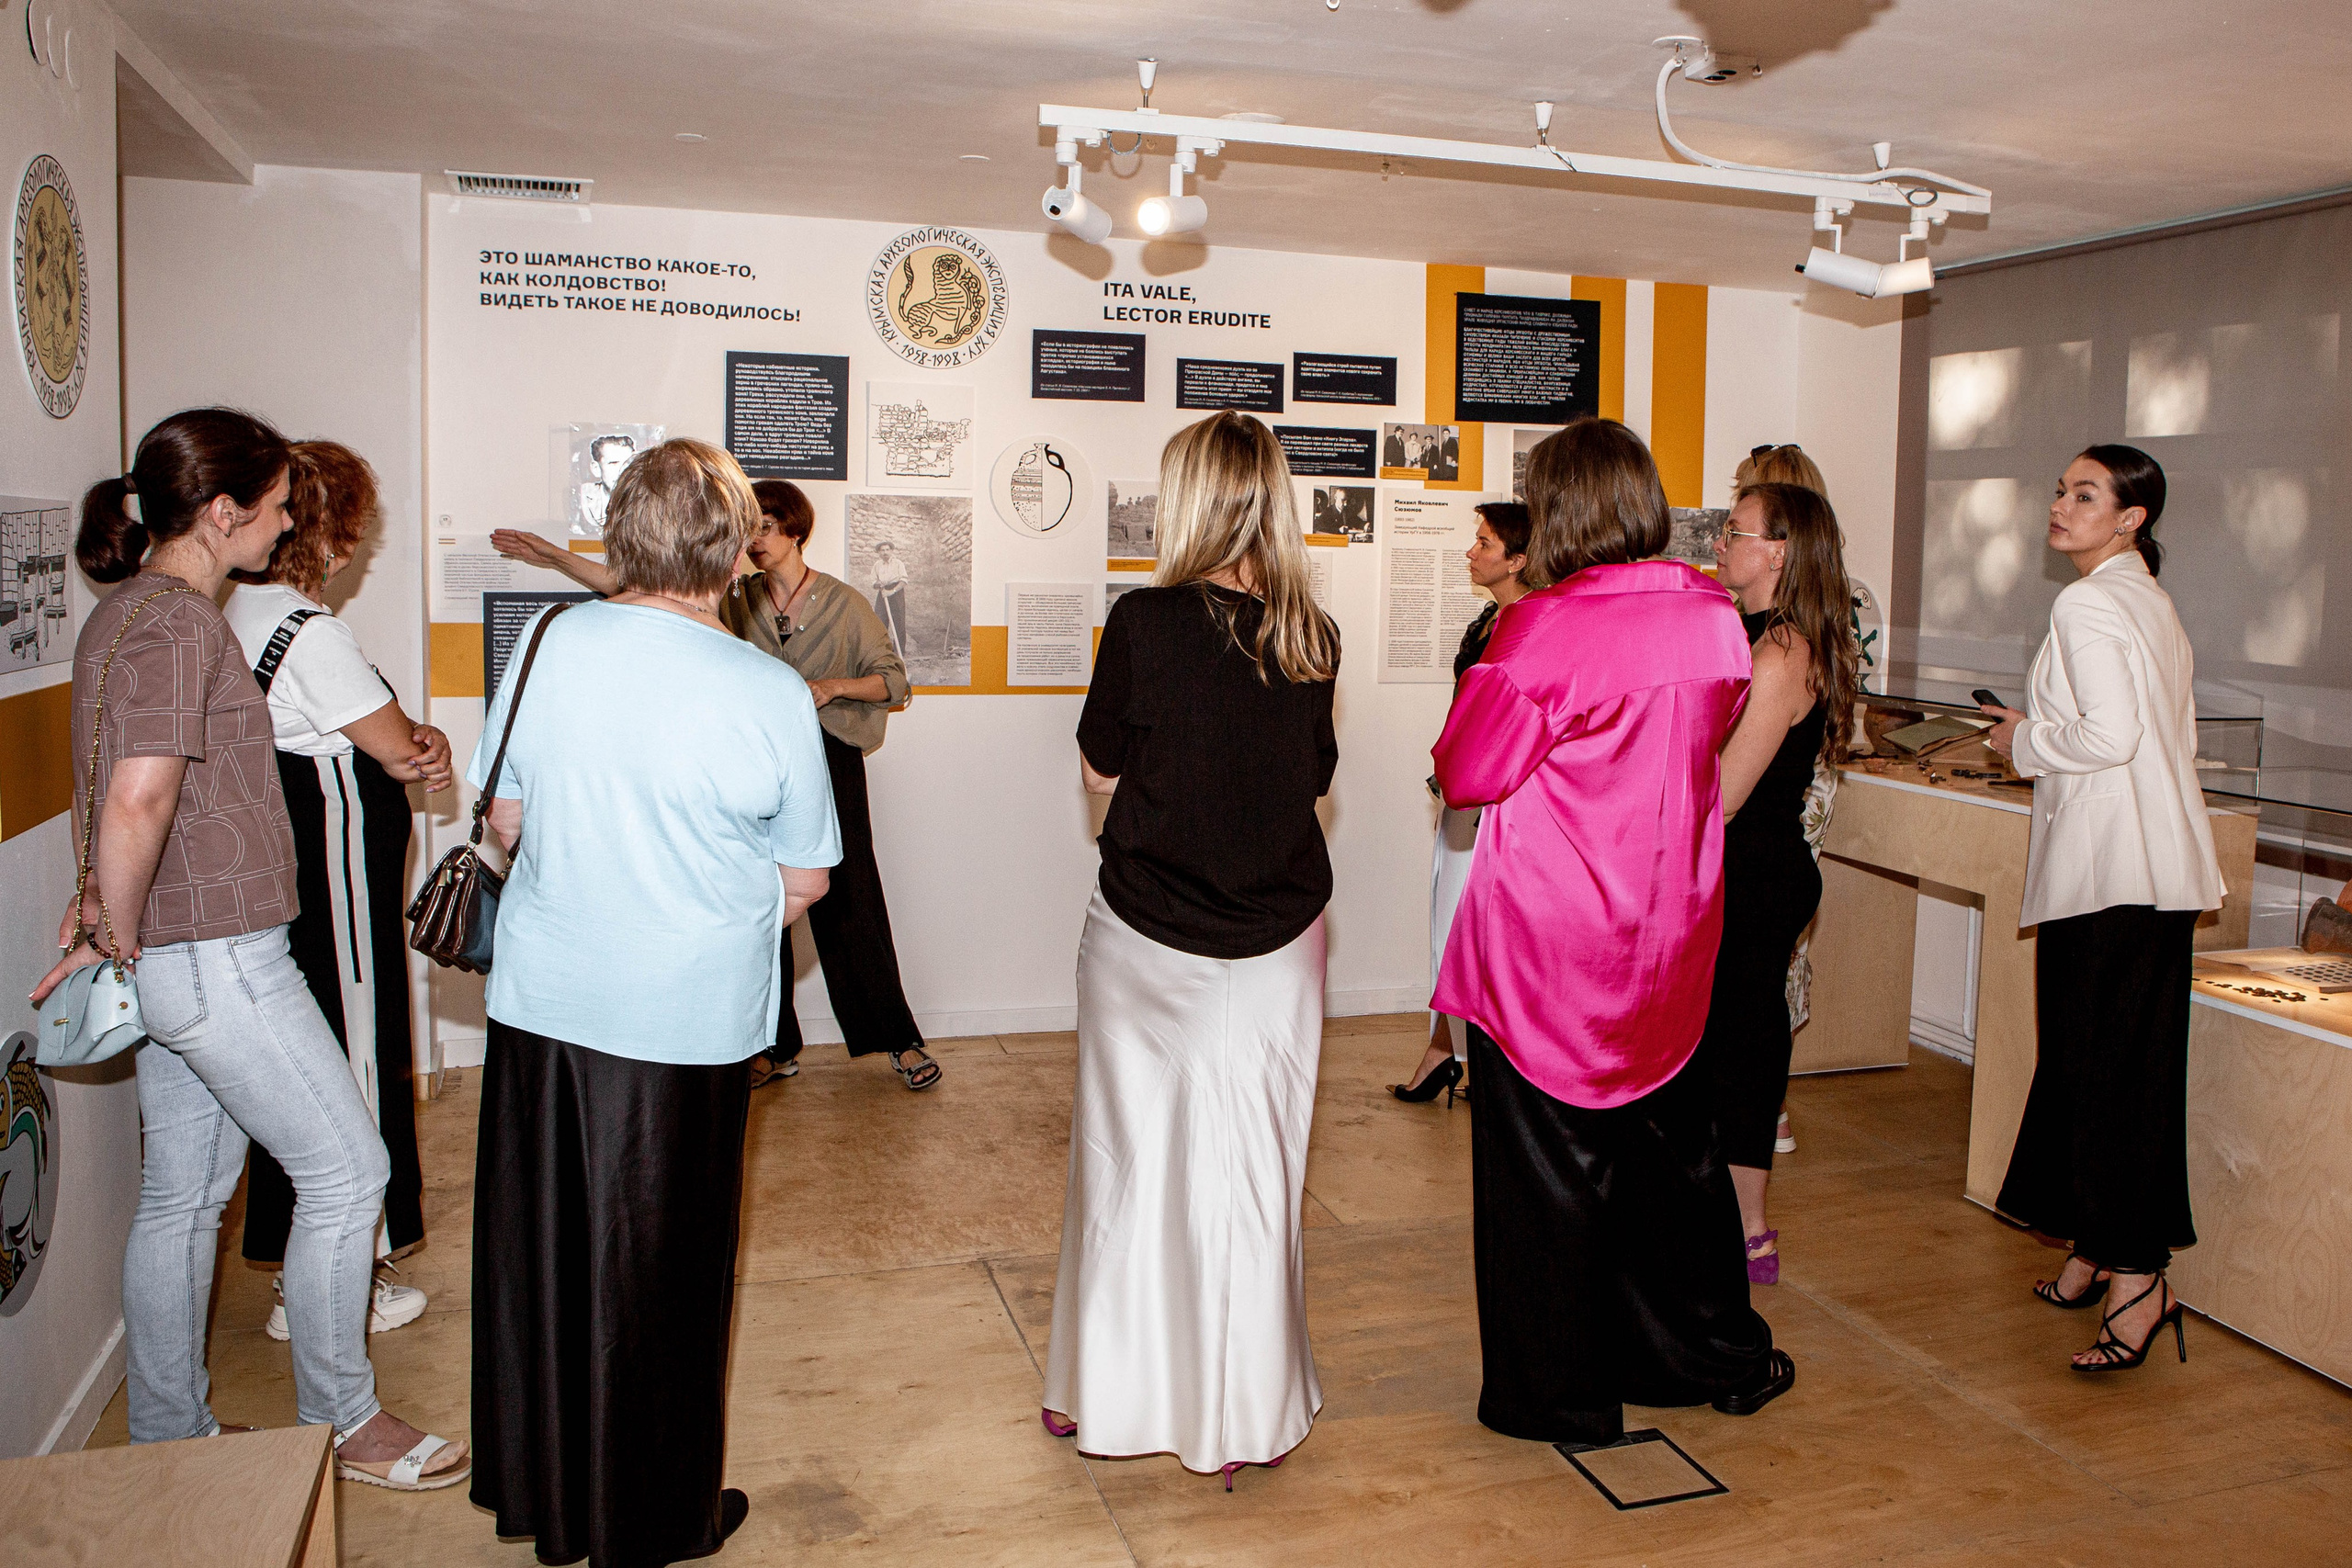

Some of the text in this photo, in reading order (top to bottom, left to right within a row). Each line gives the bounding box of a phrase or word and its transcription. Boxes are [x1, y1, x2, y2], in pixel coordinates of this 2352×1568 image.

[879, 227, 985, 270] АРХЕОЛОГИЧЕСКАЯ
[480, 250, 756, 281] ЭТО ШАМАНСТВО КАКОЕ-ТО,
[481, 271, 666, 292] КАК КОЛДОВСТВО!
[980, 255, 1006, 338] ЭКСПЕДИЦИЯ
[1103, 282, 1196, 304] ITA VALE,
[16, 237, 36, 373] КРЫМСКАЯ
[481, 292, 800, 322] ВИДЕТЬ ТАКОЕ НЕ ДОВОДИЛОСЬ!
[870, 270, 898, 343] КРЫМСКАЯ
[1103, 305, 1271, 329] LECTOR ERUDITE
[900, 344, 961, 367] 1958-1998
